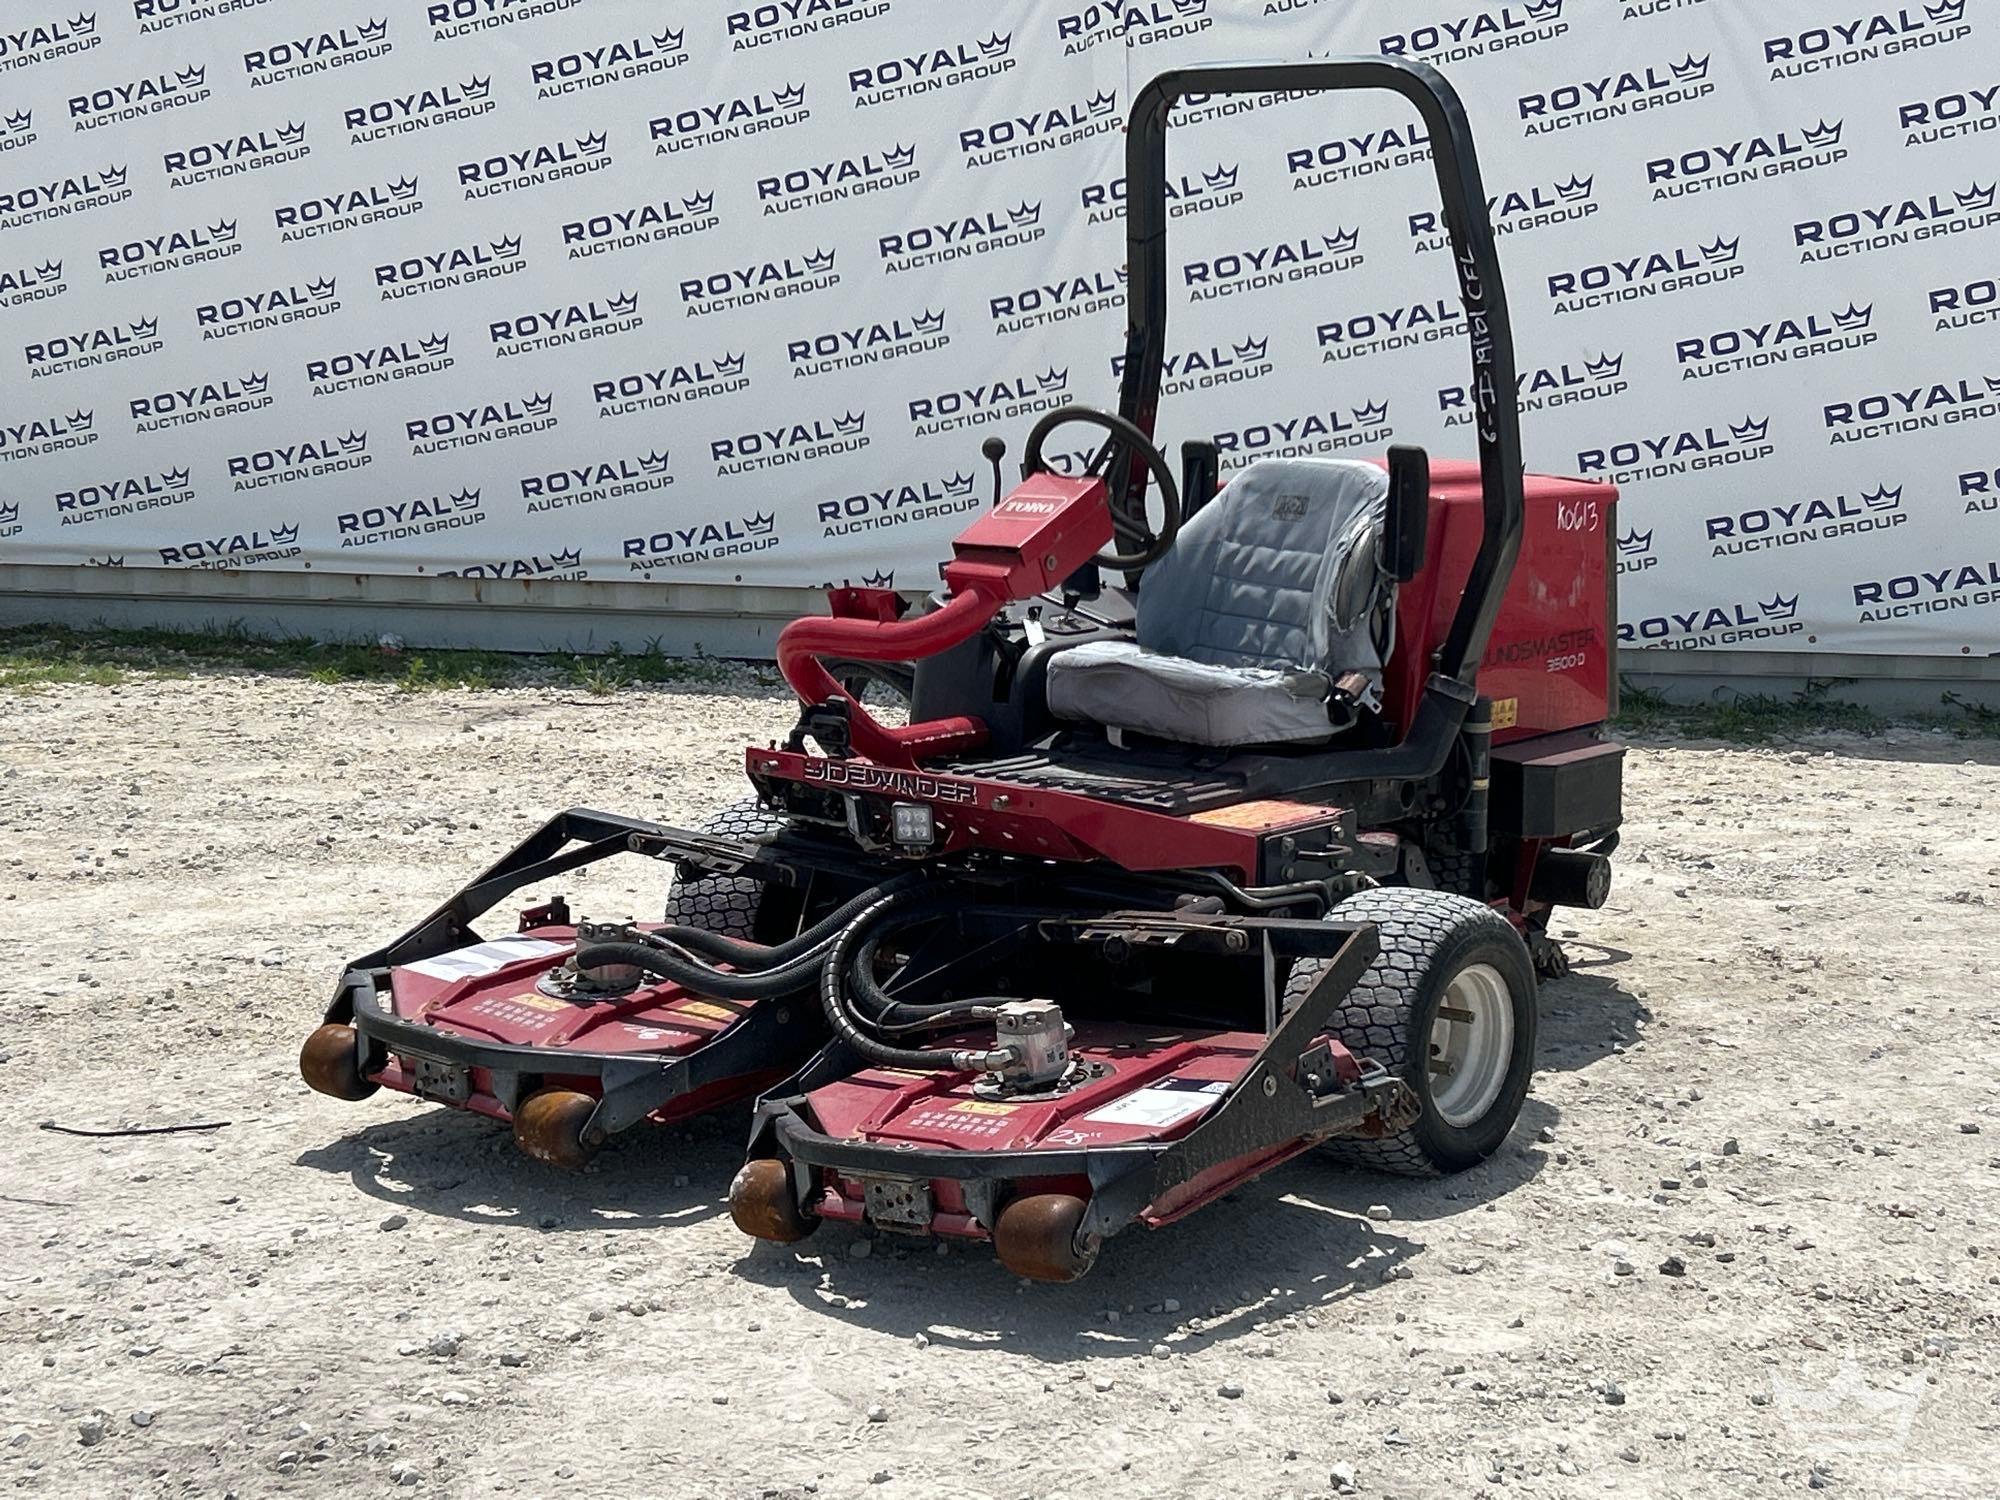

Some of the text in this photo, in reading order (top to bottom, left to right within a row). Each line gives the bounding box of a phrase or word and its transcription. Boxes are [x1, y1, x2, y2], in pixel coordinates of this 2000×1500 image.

[433, 12, 514, 42] AUCTION
[732, 2, 891, 52] AUCTION GROUP
[1138, 17, 1213, 45] GROUP
[1488, 22, 1569, 52] GROUP
[1763, 9, 1925, 64] ROYAL
[243, 29, 359, 73] ROYAL
[250, 43, 393, 89] AUCTION GROUP
[530, 38, 654, 85] ROYAL
[848, 44, 979, 93] ROYAL
[1770, 25, 1972, 82] AUCTION GROUP
[68, 75, 178, 118] ROYAL
[537, 53, 689, 100] AUCTION GROUP
[854, 58, 1016, 109] AUCTION GROUP
[1518, 67, 1670, 120] ROYAL
[74, 89, 211, 133] AUCTION GROUP
[344, 86, 462, 130] ROYAL
[350, 100, 496, 146] AUCTION GROUP
[648, 94, 774, 140] ROYAL
[959, 104, 1088, 153] ROYAL
[1524, 83, 1715, 138] AUCTION GROUP
[163, 132, 278, 174] ROYAL
[655, 109, 810, 157] AUCTION GROUP
[966, 116, 1123, 170] AUCTION GROUP
[170, 146, 311, 189] AUCTION GROUP
[457, 142, 578, 186] ROYAL
[464, 156, 612, 201] AUCTION GROUP
[757, 154, 884, 200] ROYAL
[1293, 157, 1390, 191] AUCTION
[1646, 132, 1803, 184] ROYAL
[1652, 149, 1848, 202] AUCTION GROUP
[274, 186, 390, 228] ROYAL
[763, 170, 921, 217] AUCTION GROUP
[1169, 191, 1244, 218] GROUP
[281, 201, 423, 244] AUCTION GROUP
[561, 201, 684, 245] ROYAL
[878, 212, 1008, 259] ROYAL
[1518, 202, 1599, 231] GROUP
[1793, 195, 1955, 247] ROYAL
[98, 229, 210, 269] ROYAL
[568, 216, 720, 260] AUCTION GROUP
[885, 227, 1046, 275] AUCTION GROUP
[1799, 230, 1909, 265] AUCTION
[105, 243, 242, 284] AUCTION GROUP
[374, 245, 493, 286] ROYAL
[381, 260, 527, 302] AUCTION GROUP
[679, 259, 804, 302] ROYAL
[1183, 239, 1323, 287] ROYAL
[1189, 255, 1364, 303] AUCTION GROUP
[1547, 248, 1700, 298] ROYAL
[196, 286, 309, 326] ROYAL
[686, 274, 841, 318] AUCTION GROUP
[989, 272, 1115, 320] ROYAL
[1553, 265, 1745, 315] AUCTION GROUP
[203, 301, 341, 342] AUCTION GROUP
[489, 301, 609, 343] ROYAL
[496, 317, 644, 359] AUCTION GROUP
[996, 304, 1081, 336] AUCTION
[1316, 299, 1460, 347] ROYAL
[1675, 315, 1833, 364] ROYAL
[24, 326, 132, 365] ROYAL
[31, 340, 164, 379] AUCTION GROUP
[306, 342, 421, 382] ROYAL
[787, 320, 913, 363] ROYAL
[793, 335, 950, 379] AUCTION GROUP
[1322, 332, 1419, 364] AUCTION
[1682, 332, 1878, 381] AUCTION GROUP
[312, 357, 455, 397] AUCTION GROUP
[592, 362, 715, 403] ROYAL
[1199, 363, 1273, 389] GROUP
[1547, 381, 1628, 407] GROUP
[129, 381, 242, 419] ROYAL
[136, 396, 274, 434] AUCTION GROUP
[599, 378, 750, 419] AUCTION GROUP
[908, 377, 1037, 422] ROYAL
[915, 393, 1073, 438] AUCTION GROUP
[1823, 379, 1985, 428] ROYAL
[405, 402, 524, 441] ROYAL
[412, 417, 558, 456] AUCTION GROUP
[710, 420, 834, 462] ROYAL
[1317, 427, 1394, 452] GROUP
[1829, 414, 1939, 446] AUCTION
[227, 439, 340, 477] ROYAL
[717, 436, 870, 477] AUCTION GROUP
[1577, 427, 1730, 474] ROYAL
[1691, 445, 1774, 471] GROUP
[55, 475, 163, 512] ROYAL
[234, 455, 372, 492] AUCTION GROUP
[520, 459, 640, 499] ROYAL
[527, 475, 674, 514] AUCTION GROUP
[61, 490, 195, 527] AUCTION GROUP
[337, 496, 452, 534] ROYAL
[817, 482, 943, 523] ROYAL
[823, 498, 980, 538] AUCTION GROUP
[1705, 495, 1862, 541] ROYAL
[158, 531, 269, 565] ROYAL
[341, 512, 486, 548] AUCTION GROUP
[623, 520, 745, 559] ROYAL
[1712, 513, 1908, 558] AUCTION GROUP
[630, 536, 779, 572] AUCTION GROUP
[1859, 595, 1968, 624] AUCTION
[1483, 627, 1596, 666] UNDSMASTER
[1721, 622, 1804, 644] GROUP
[803, 761, 978, 806] SIDEWINDER
